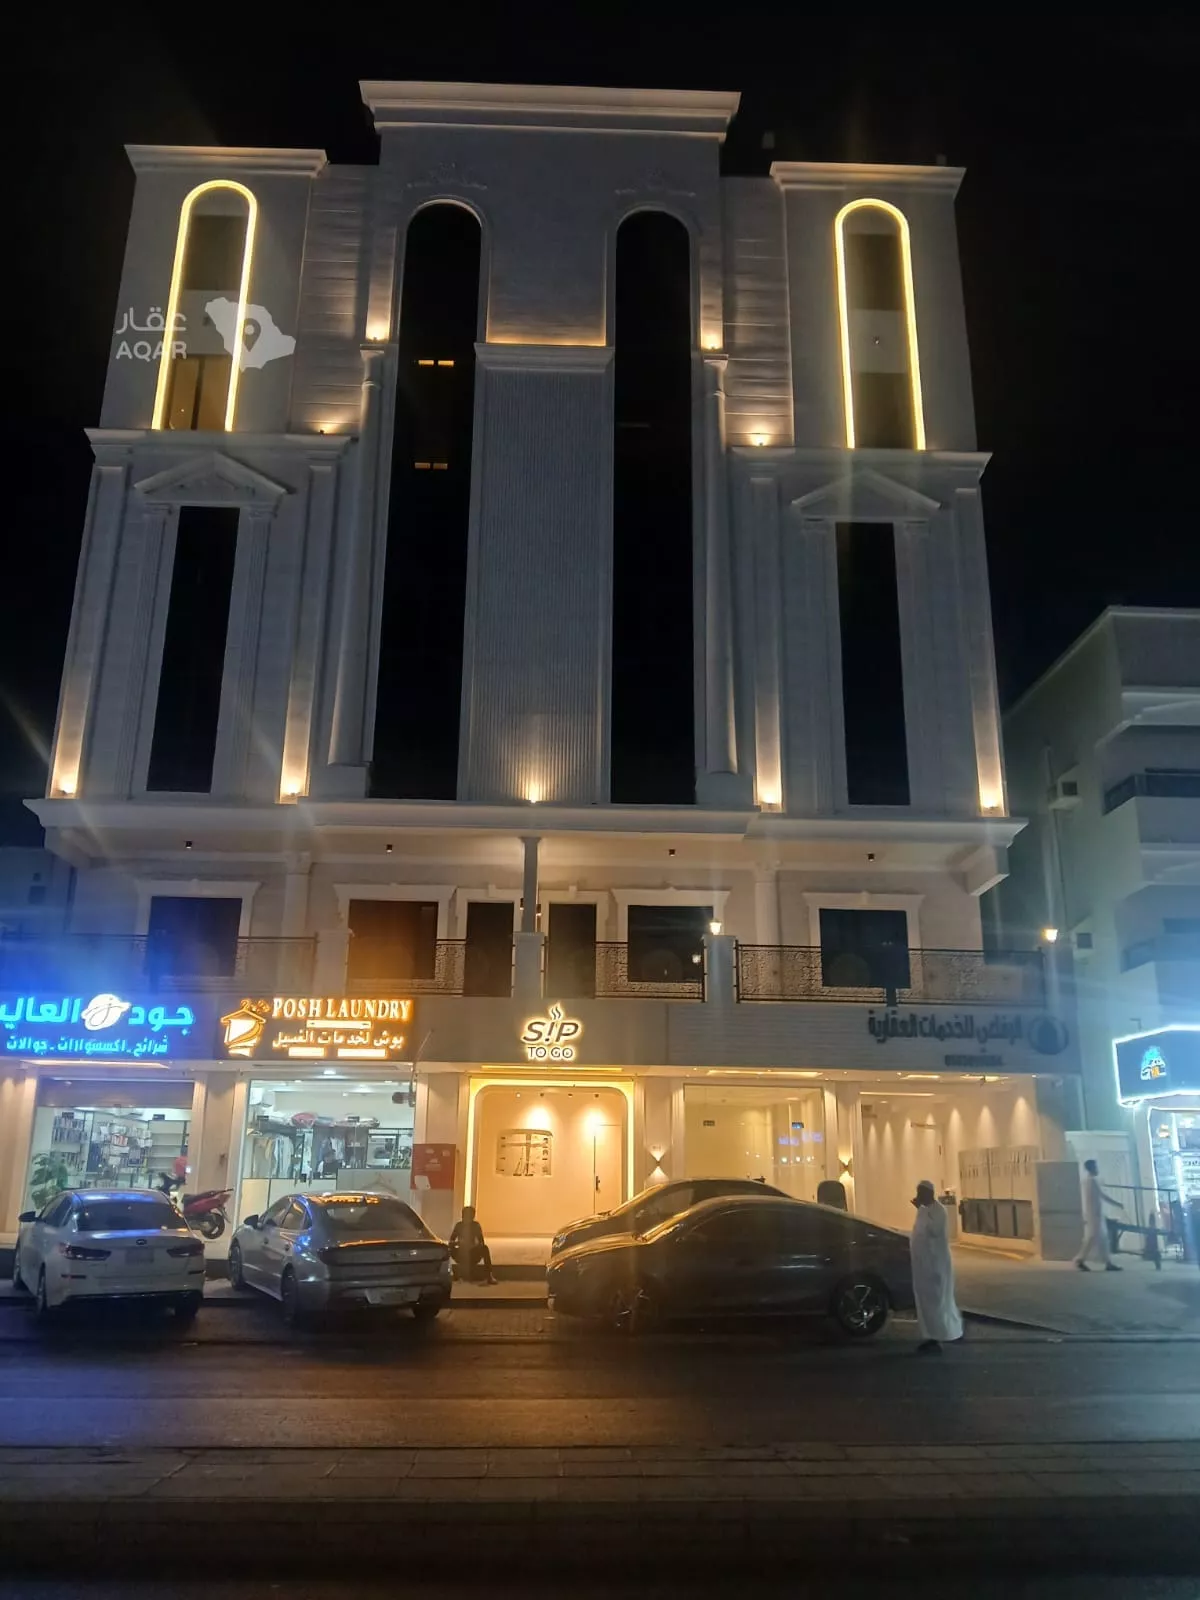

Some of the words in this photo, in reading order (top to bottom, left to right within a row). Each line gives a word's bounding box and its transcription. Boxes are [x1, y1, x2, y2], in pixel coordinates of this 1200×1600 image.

[0, 997, 82, 1029] العالي
[128, 1005, 195, 1035] جود
[272, 998, 322, 1018] POSH
[325, 999, 412, 1020] LAUNDRY
[868, 1010, 918, 1044] العقارية
[6, 1035, 48, 1056] جوالات
[133, 1035, 168, 1057] شرائح
[272, 1029, 314, 1048] الغسيل
[527, 1046, 547, 1058] TO
[551, 1046, 573, 1059] GO
